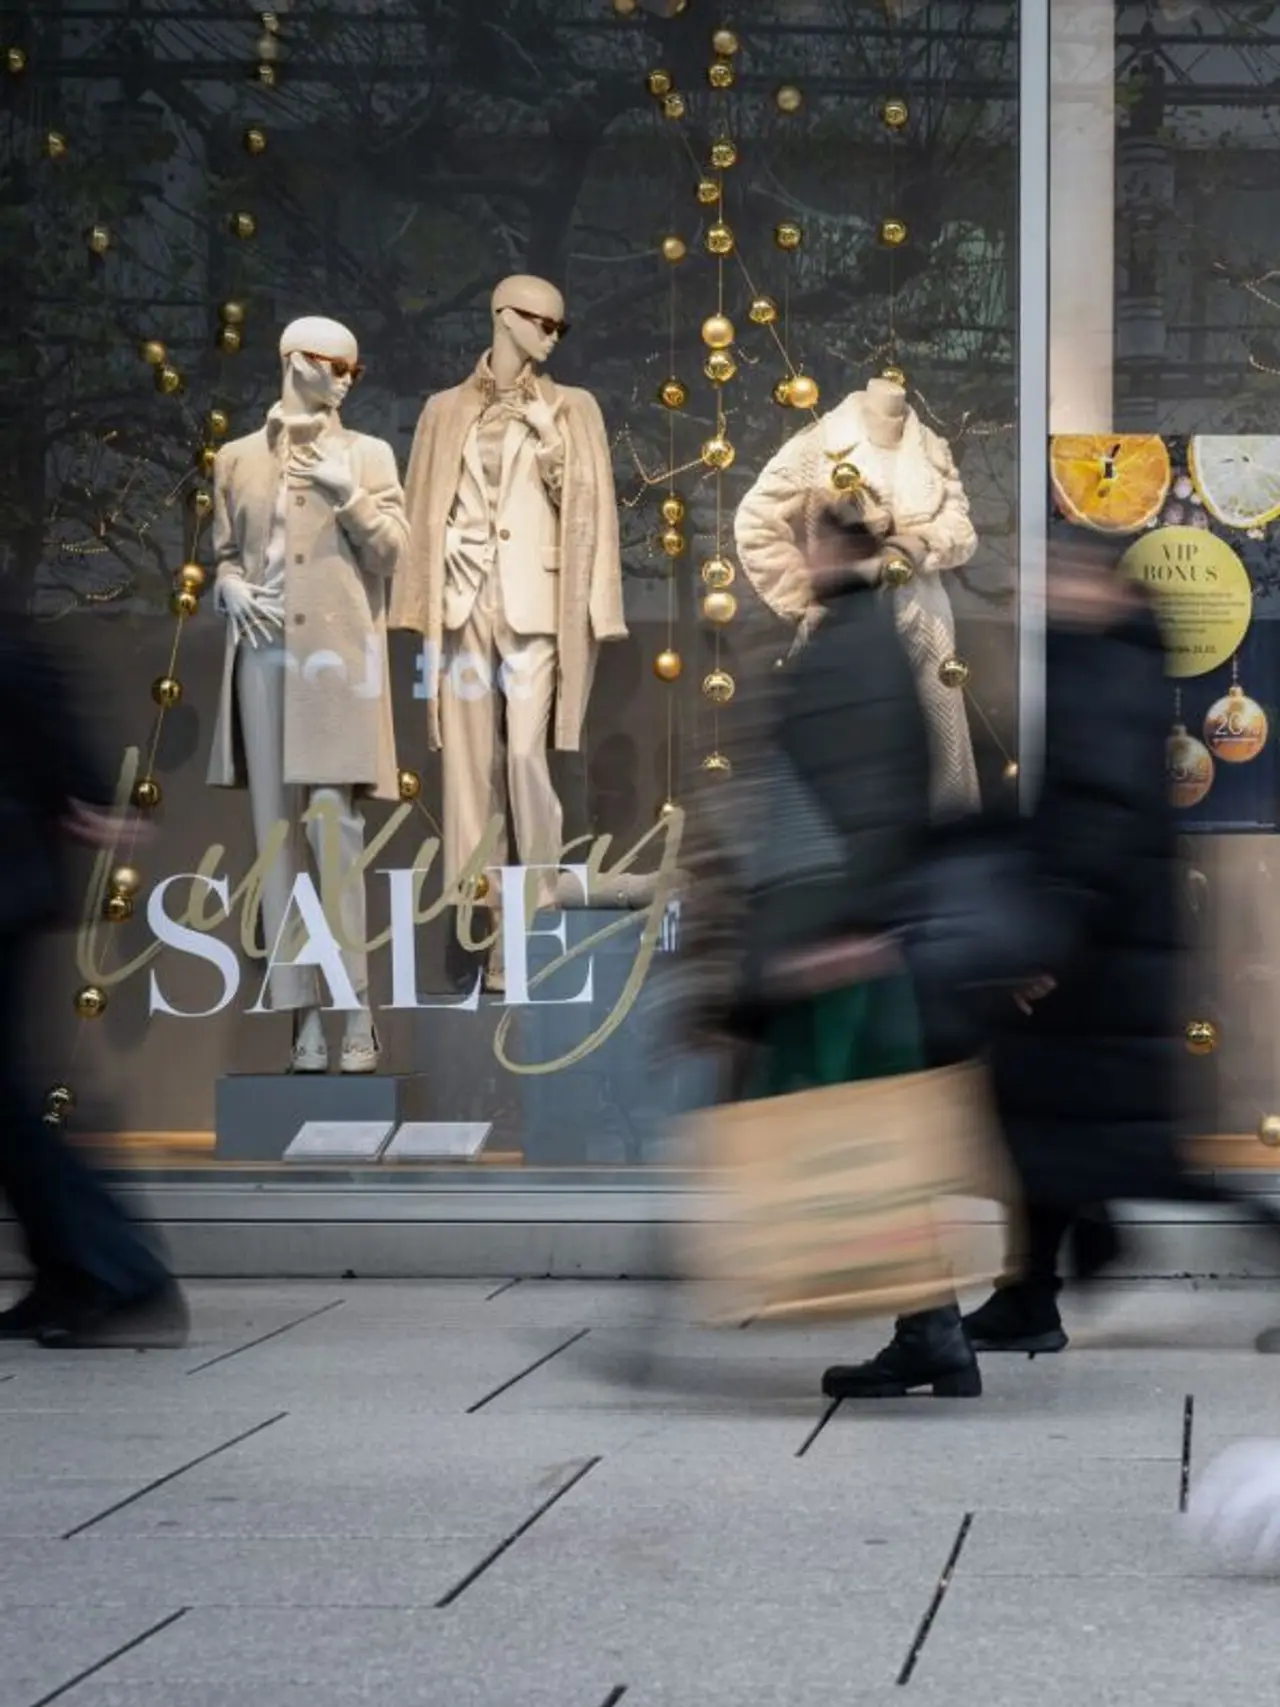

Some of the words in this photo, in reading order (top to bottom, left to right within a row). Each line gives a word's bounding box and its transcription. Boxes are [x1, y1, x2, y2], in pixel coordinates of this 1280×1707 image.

[1161, 543, 1198, 562] VIP
[1143, 564, 1218, 582] BONUS
[145, 863, 595, 1018] SALE
